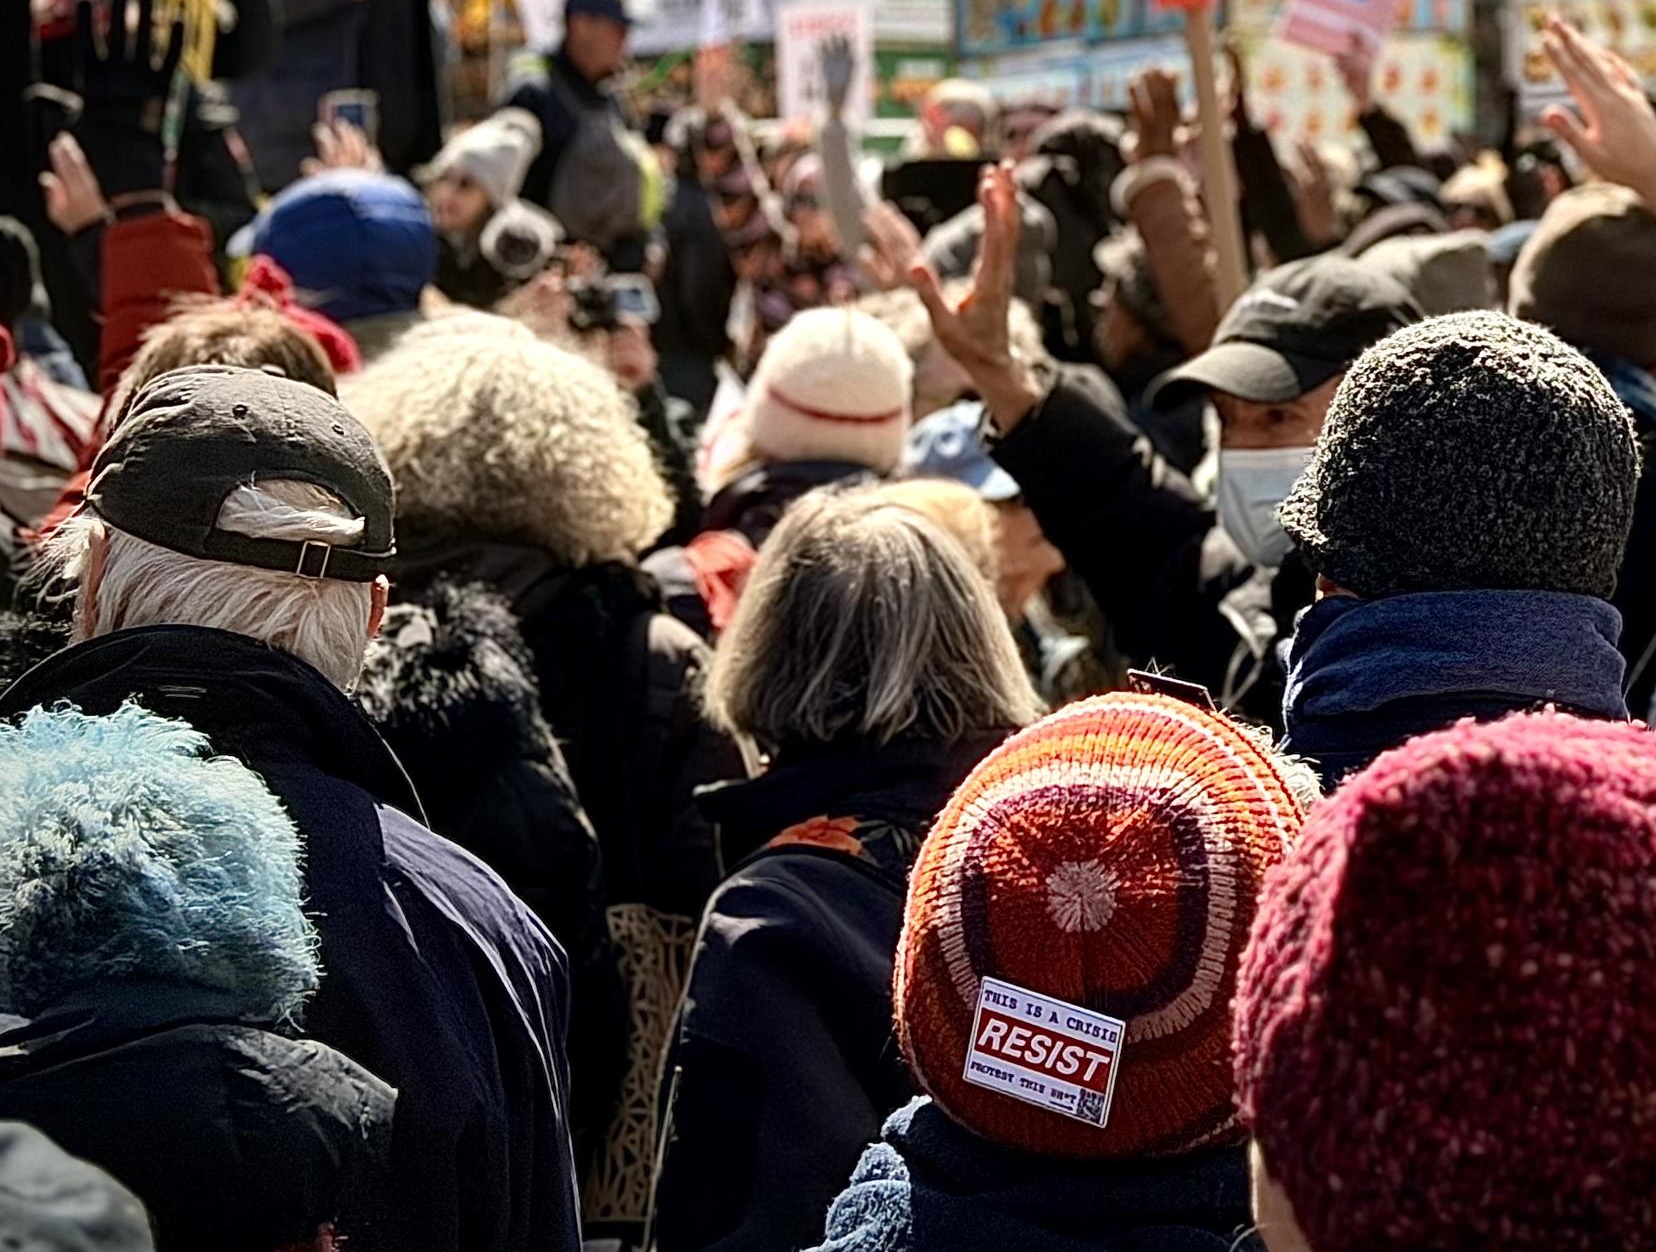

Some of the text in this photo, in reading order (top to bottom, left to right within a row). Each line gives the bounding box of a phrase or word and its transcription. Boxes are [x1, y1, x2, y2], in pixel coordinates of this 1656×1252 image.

[984, 989, 1118, 1044] THIS IS A CRISIS
[970, 1061, 1016, 1082] PROTEST
[1020, 1077, 1046, 1094] THIS
[977, 1017, 1111, 1083] RESIST
